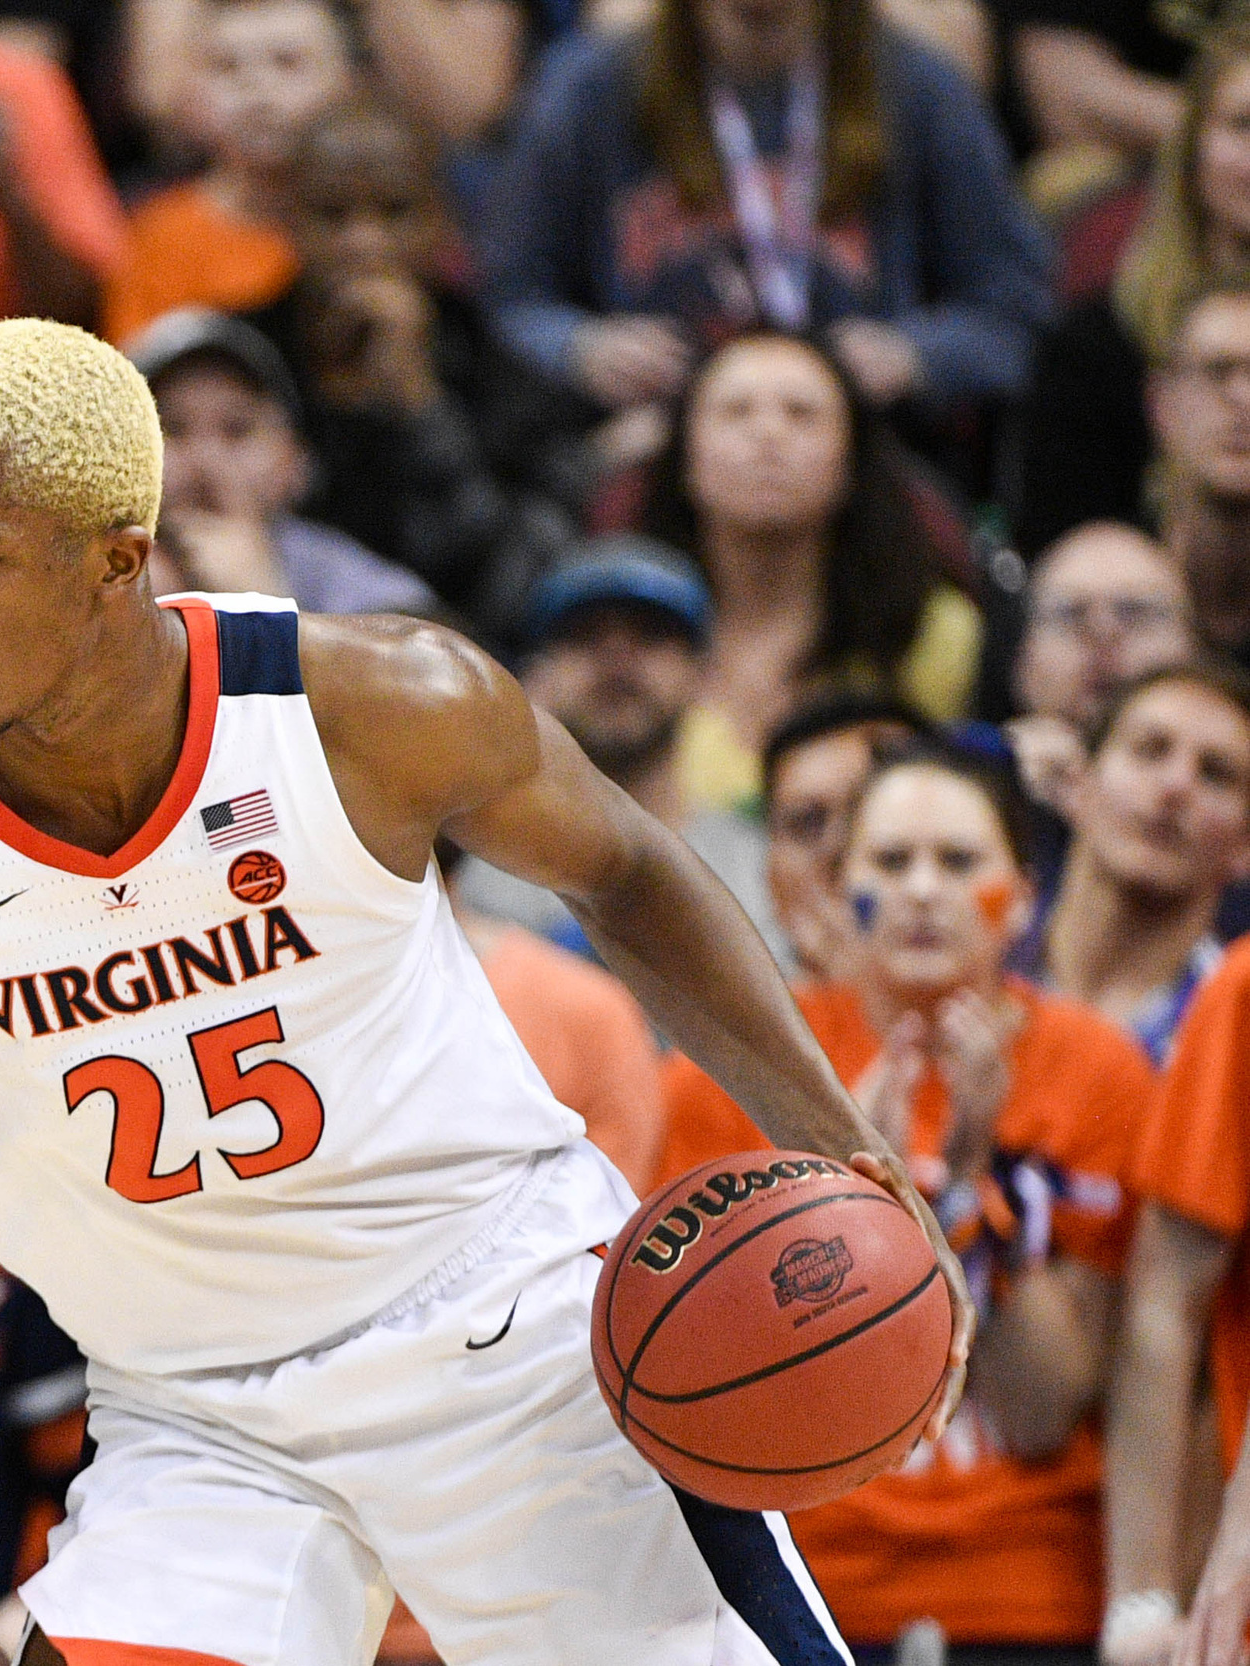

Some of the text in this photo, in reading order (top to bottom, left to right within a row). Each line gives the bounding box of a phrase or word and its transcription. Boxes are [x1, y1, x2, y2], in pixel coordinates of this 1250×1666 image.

[239, 864, 279, 885] ACC
[63, 1005, 325, 1204] 25
[630, 1160, 856, 1275] Wilson
